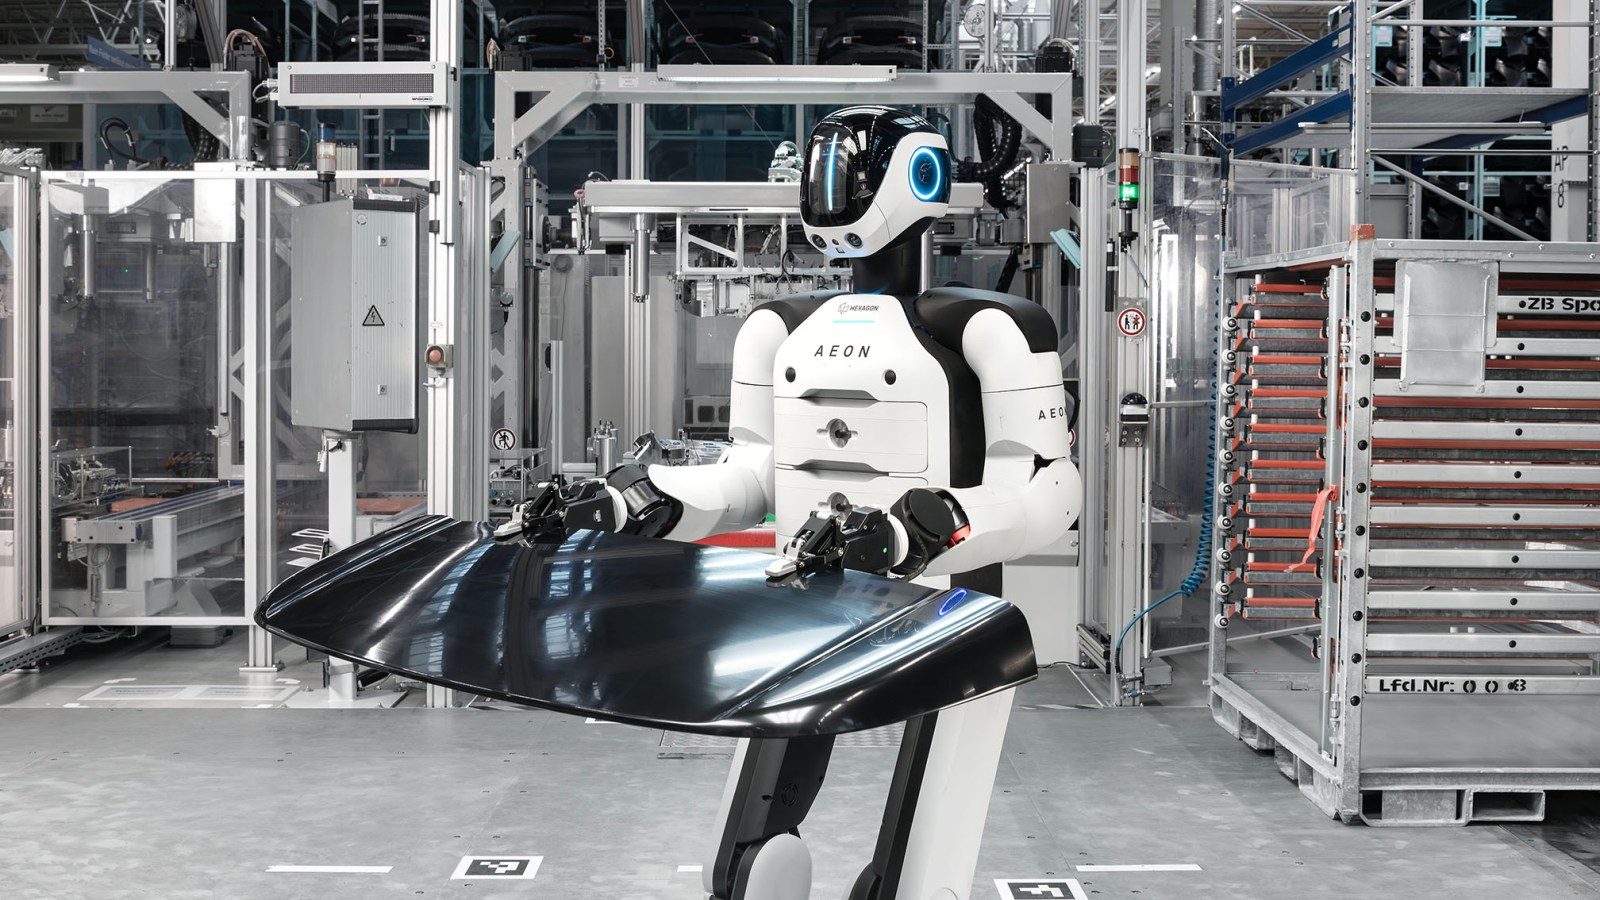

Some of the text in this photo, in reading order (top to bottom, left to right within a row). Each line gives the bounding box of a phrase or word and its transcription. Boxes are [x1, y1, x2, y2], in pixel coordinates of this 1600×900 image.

[1528, 297, 1555, 310] ZB
[814, 345, 870, 358] AEON
[1038, 406, 1066, 420] AEO
[1379, 679, 1455, 692] Lfd.Nr:
